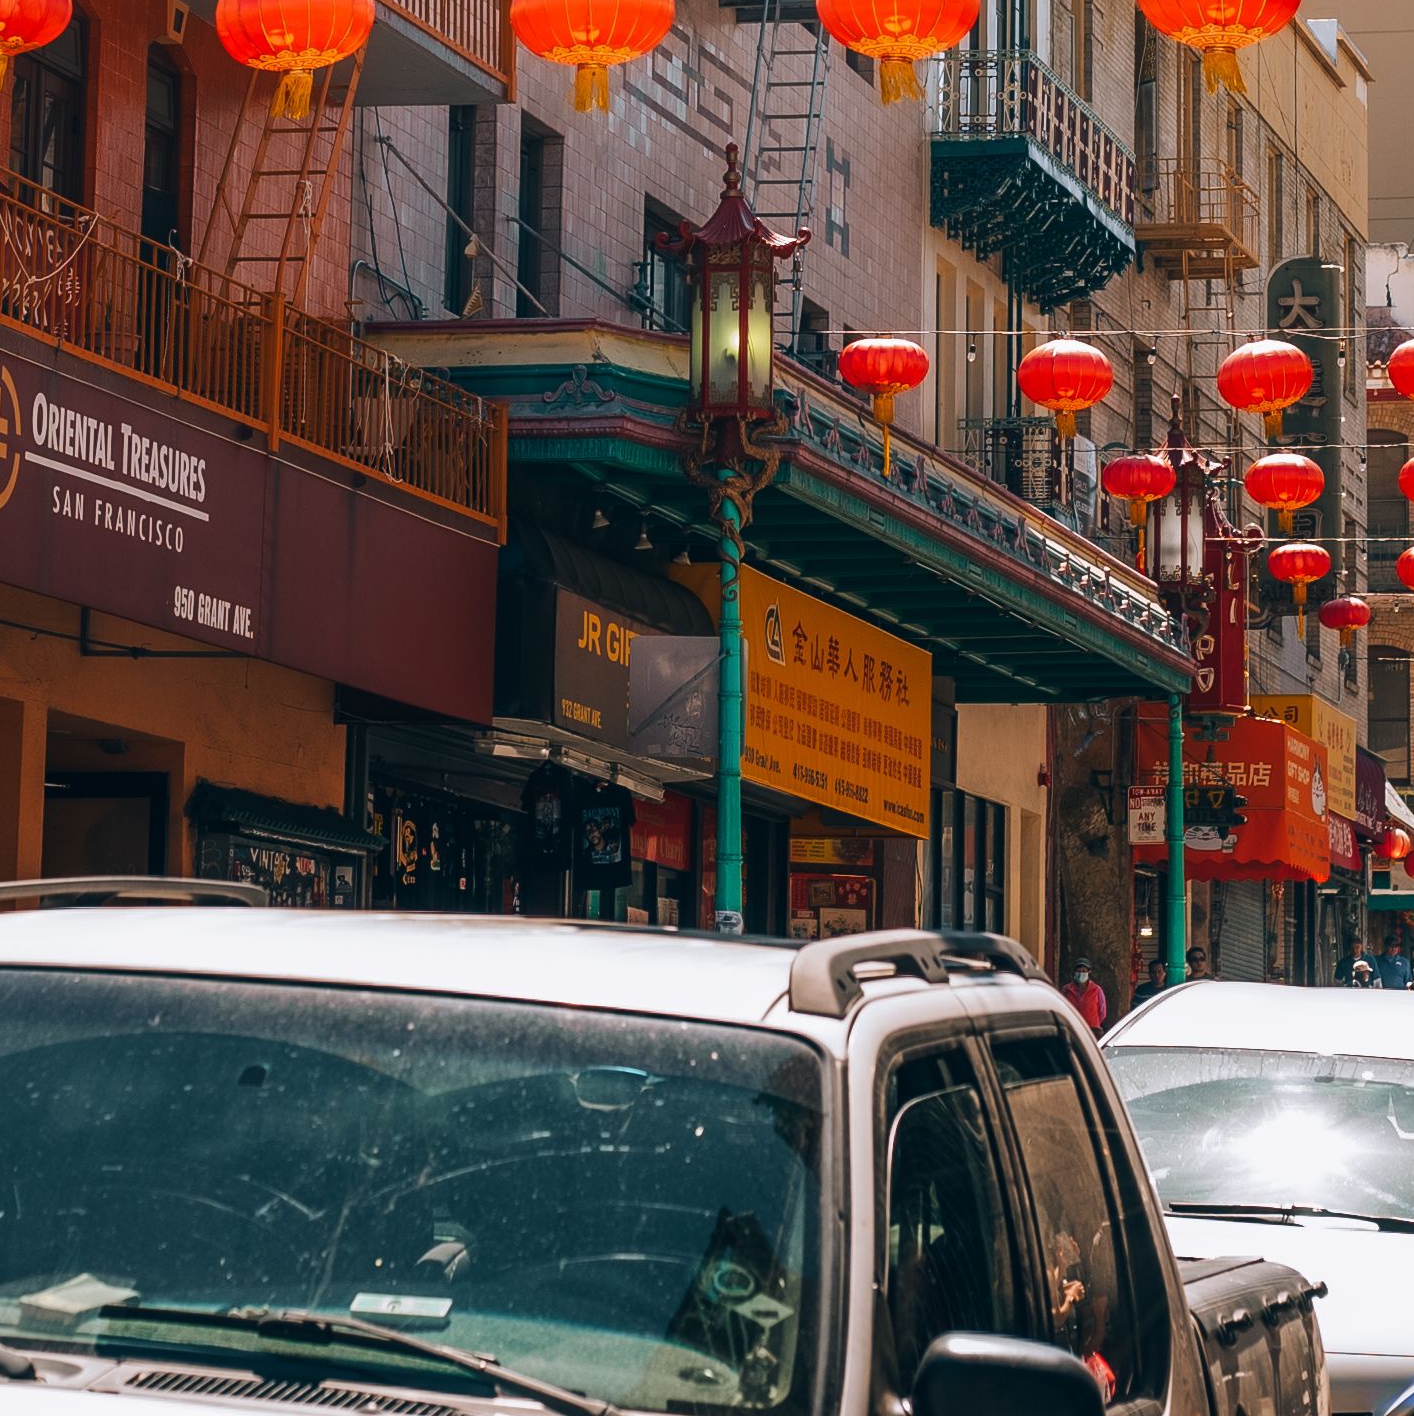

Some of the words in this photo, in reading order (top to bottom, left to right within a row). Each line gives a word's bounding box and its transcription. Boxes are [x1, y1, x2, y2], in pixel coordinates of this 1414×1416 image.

[32, 392, 114, 471] ORIENTAL
[121, 423, 206, 503] TREASURES
[52, 485, 84, 521] SAN
[95, 499, 184, 553] FRANCISCO
[174, 585, 194, 621] 950
[198, 592, 230, 633] GRANT
[233, 604, 254, 639] AVE.
[578, 610, 601, 657] JR
[606, 622, 636, 667] GIF
[791, 620, 911, 707] 金山華人服務社
[561, 698, 573, 718] 932
[573, 702, 591, 726] GRANT
[1251, 704, 1299, 724] 公司
[1130, 797, 1141, 809] NO
[1138, 812, 1156, 822] ANY
